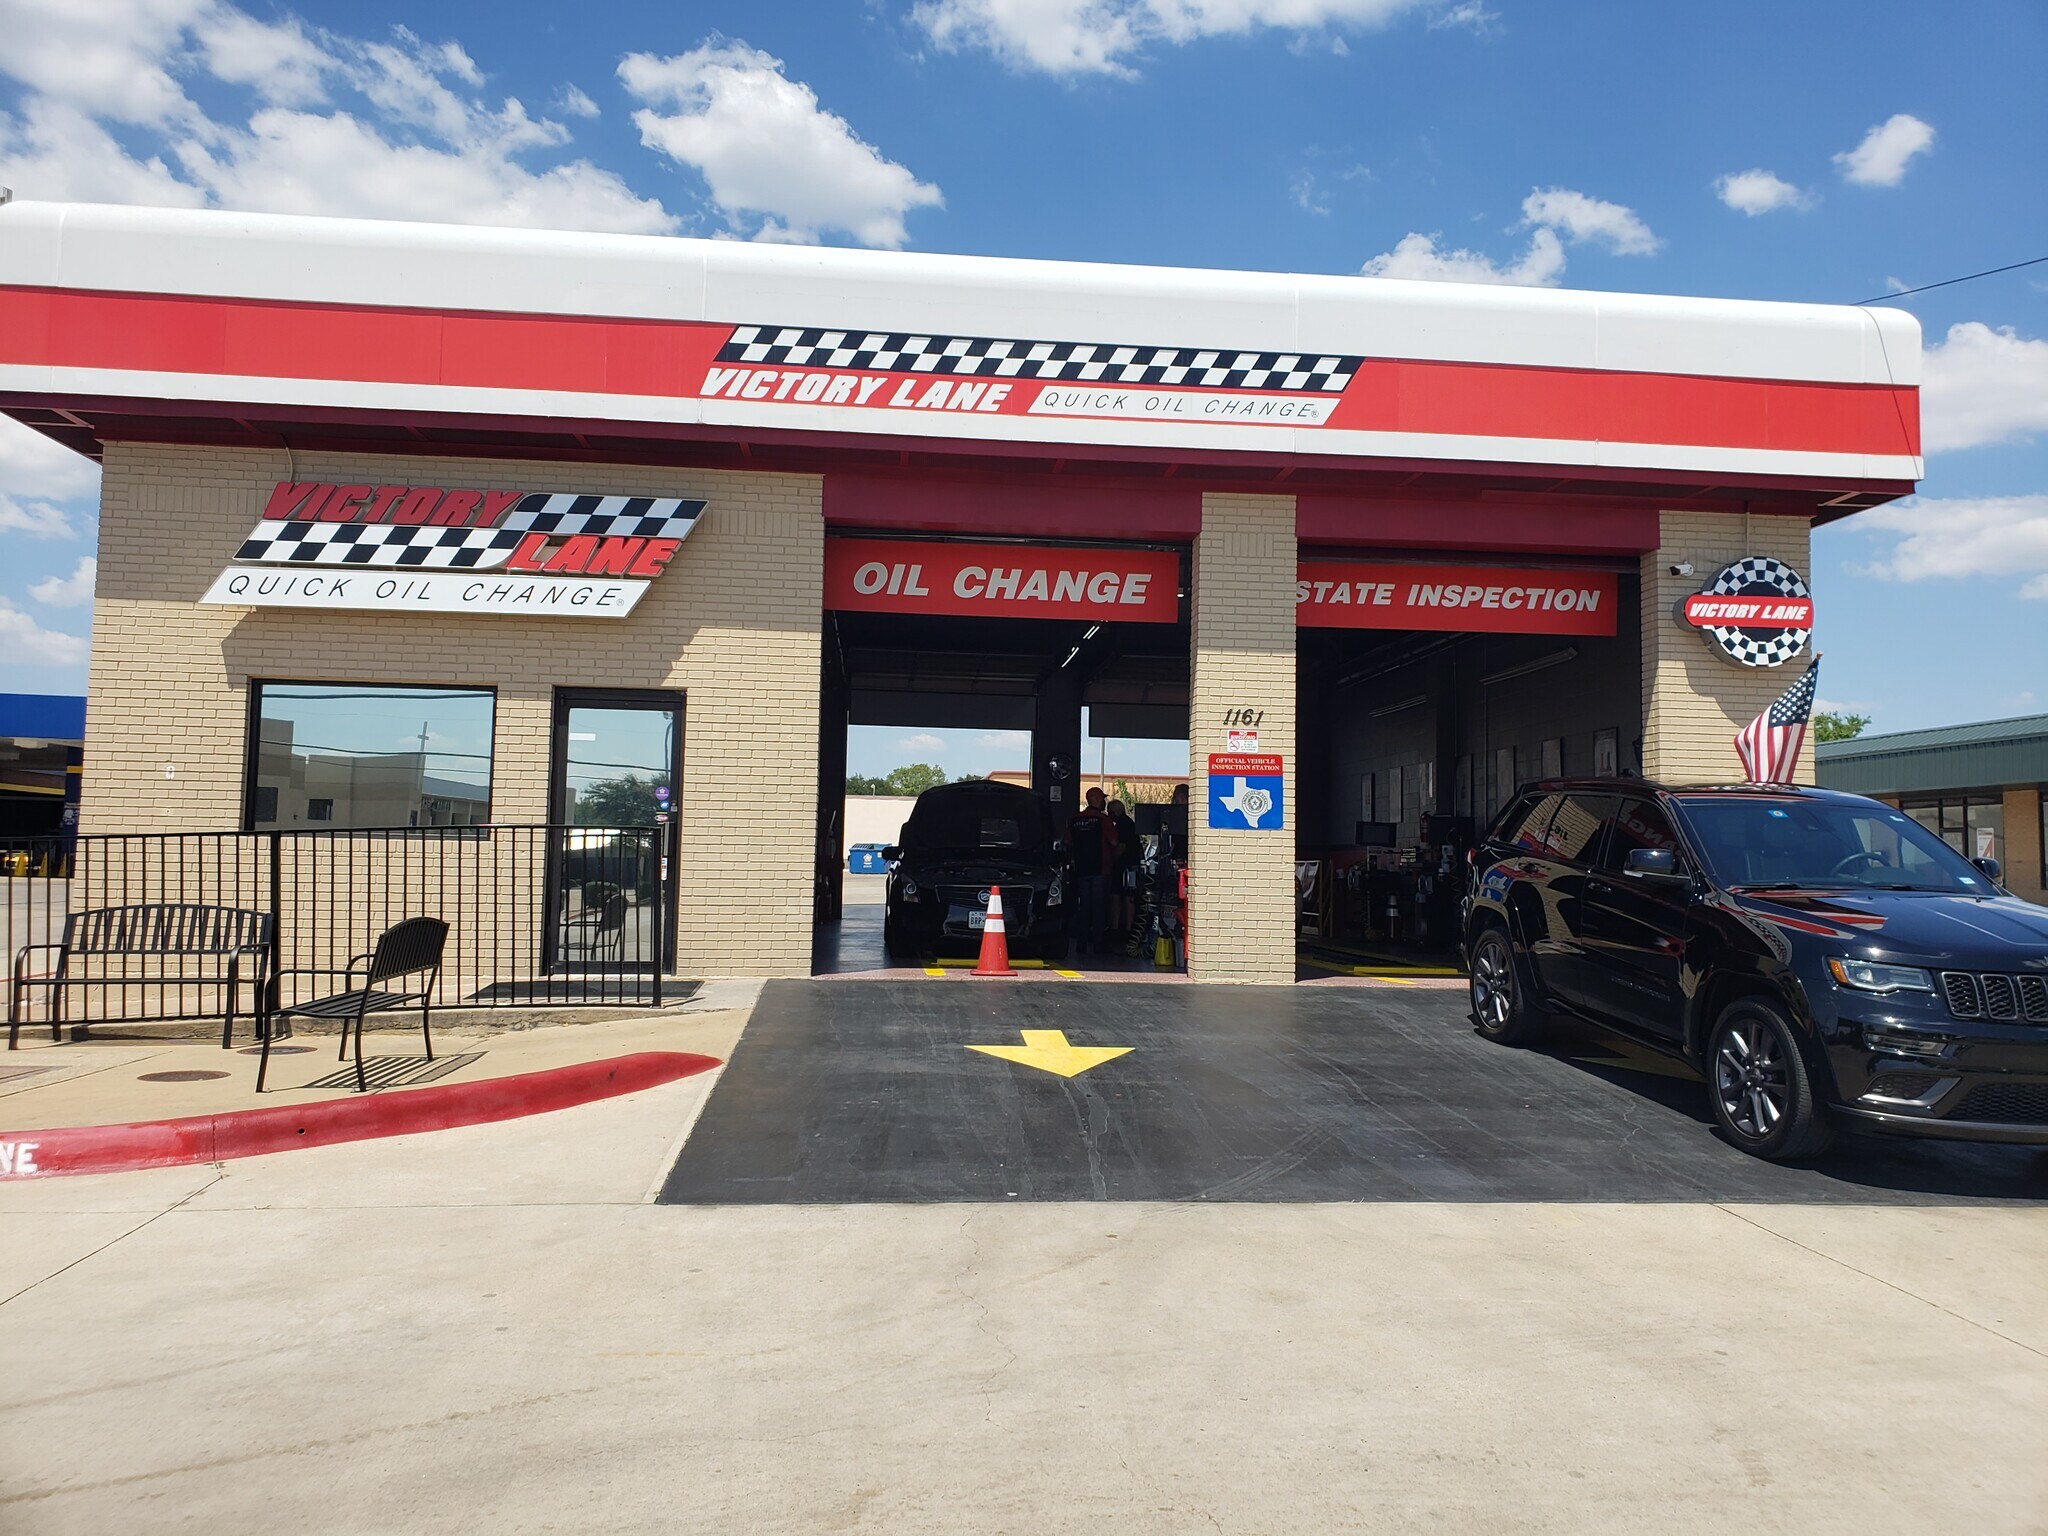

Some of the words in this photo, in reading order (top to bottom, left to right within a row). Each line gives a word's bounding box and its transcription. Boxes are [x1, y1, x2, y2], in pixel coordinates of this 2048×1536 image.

[699, 368, 888, 404] VICTORY
[889, 379, 1013, 411] LANE
[1044, 392, 1127, 411] QUICK
[1145, 397, 1186, 412] OIL
[263, 482, 523, 527] VICTORY
[507, 533, 682, 577] LANE
[228, 574, 352, 597] QUICK
[375, 579, 432, 601] OIL
[853, 562, 929, 597] OIL
[954, 566, 1152, 605] CHANGE
[1296, 580, 1396, 605] STATE
[1407, 584, 1600, 611] INSPECTION
[1689, 603, 1761, 618] VICTORY
[1762, 605, 1808, 620] LANE
[1223, 708, 1264, 727] 1161
